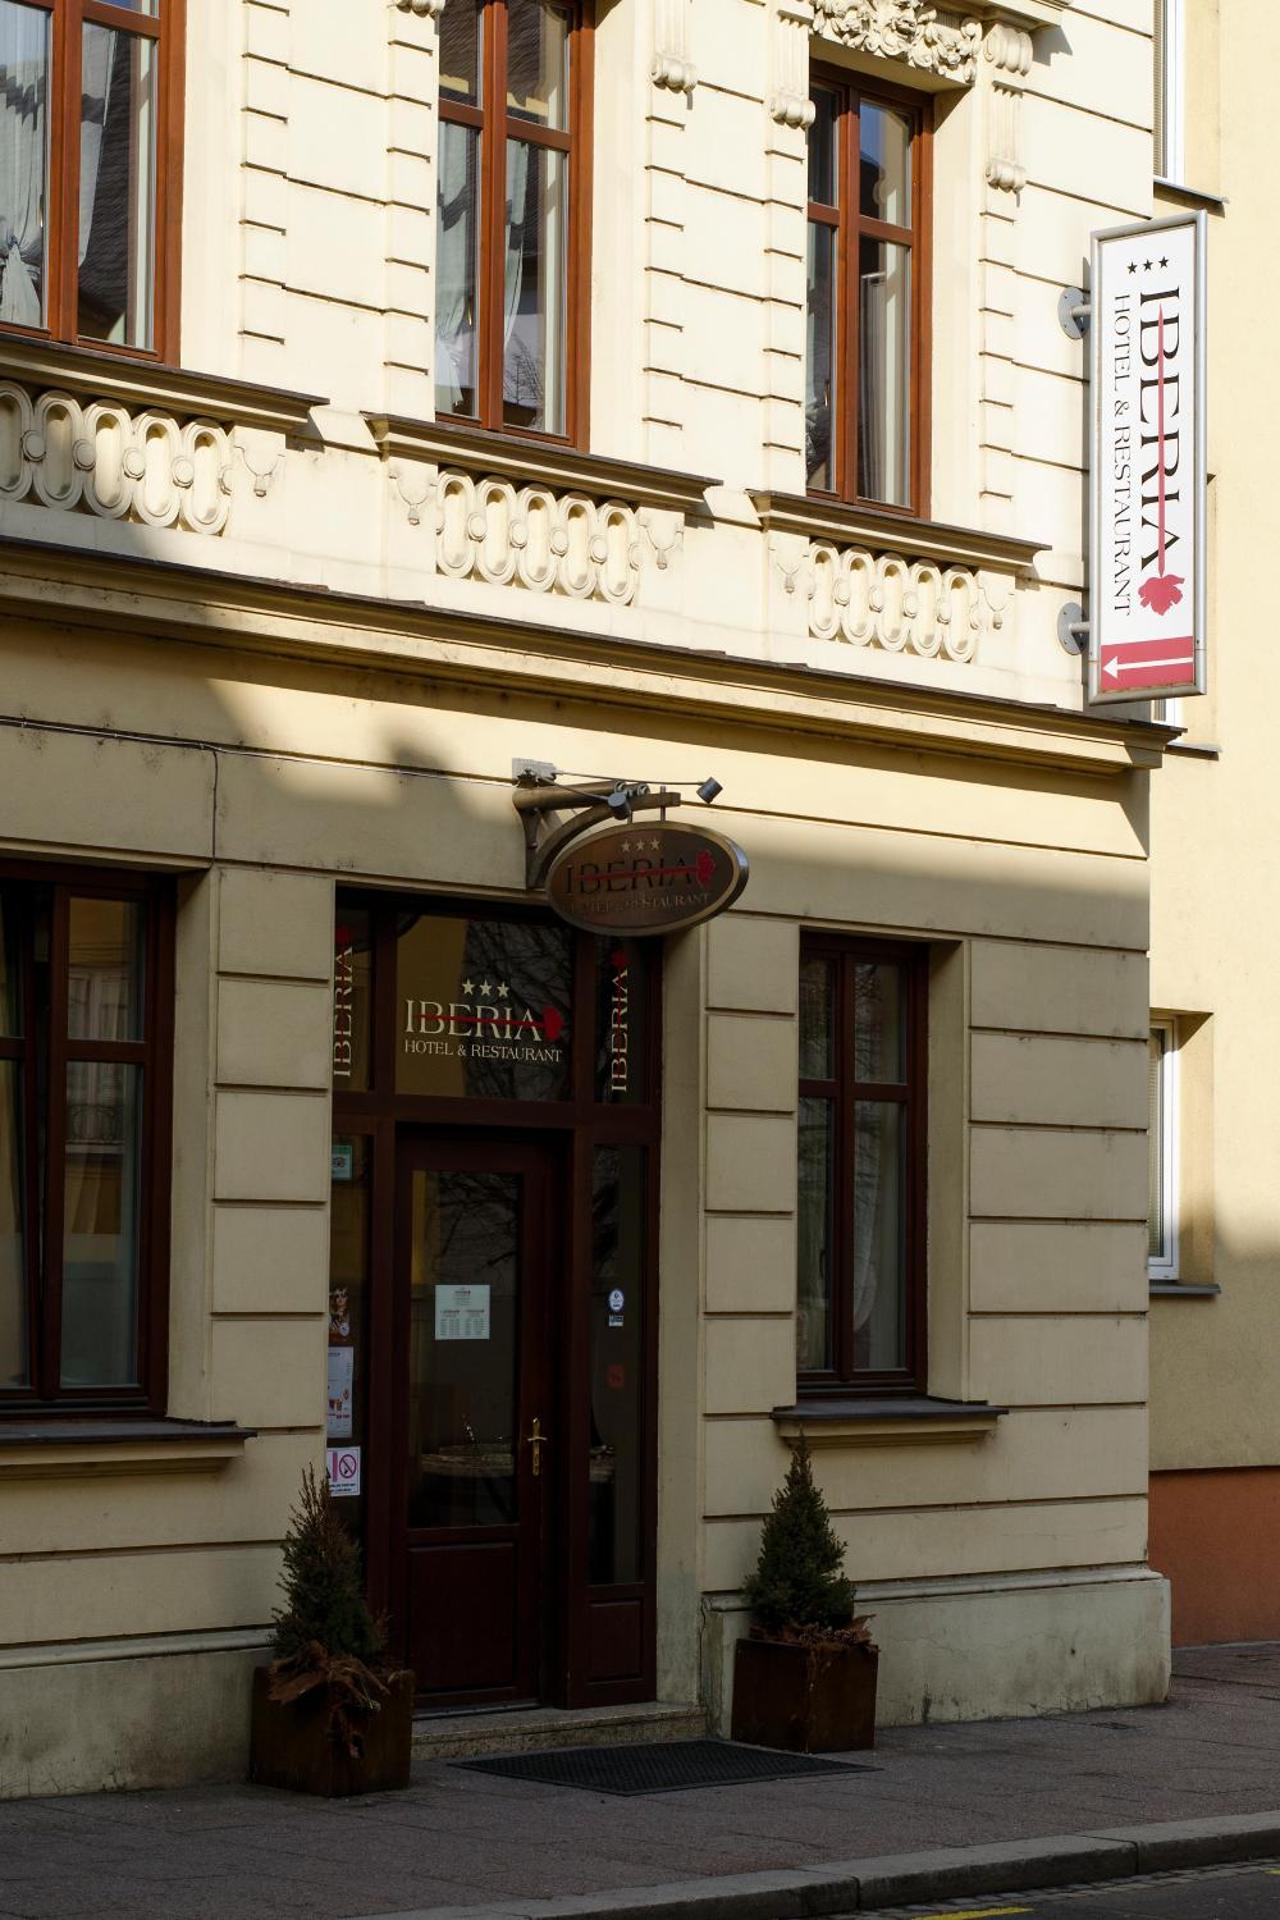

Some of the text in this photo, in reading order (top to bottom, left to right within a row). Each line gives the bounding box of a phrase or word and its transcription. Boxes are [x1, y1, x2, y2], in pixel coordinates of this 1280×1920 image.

[1114, 294, 1131, 616] HOTEL & RESTAURANT
[1140, 286, 1180, 571] IBERIA
[565, 857, 692, 895] IBERIA
[334, 946, 352, 1077] IBERIA
[404, 1039, 562, 1063] HOTEL & RESTAURANT
[405, 999, 542, 1041] IBERIA
[611, 968, 628, 1092] IBERIA
